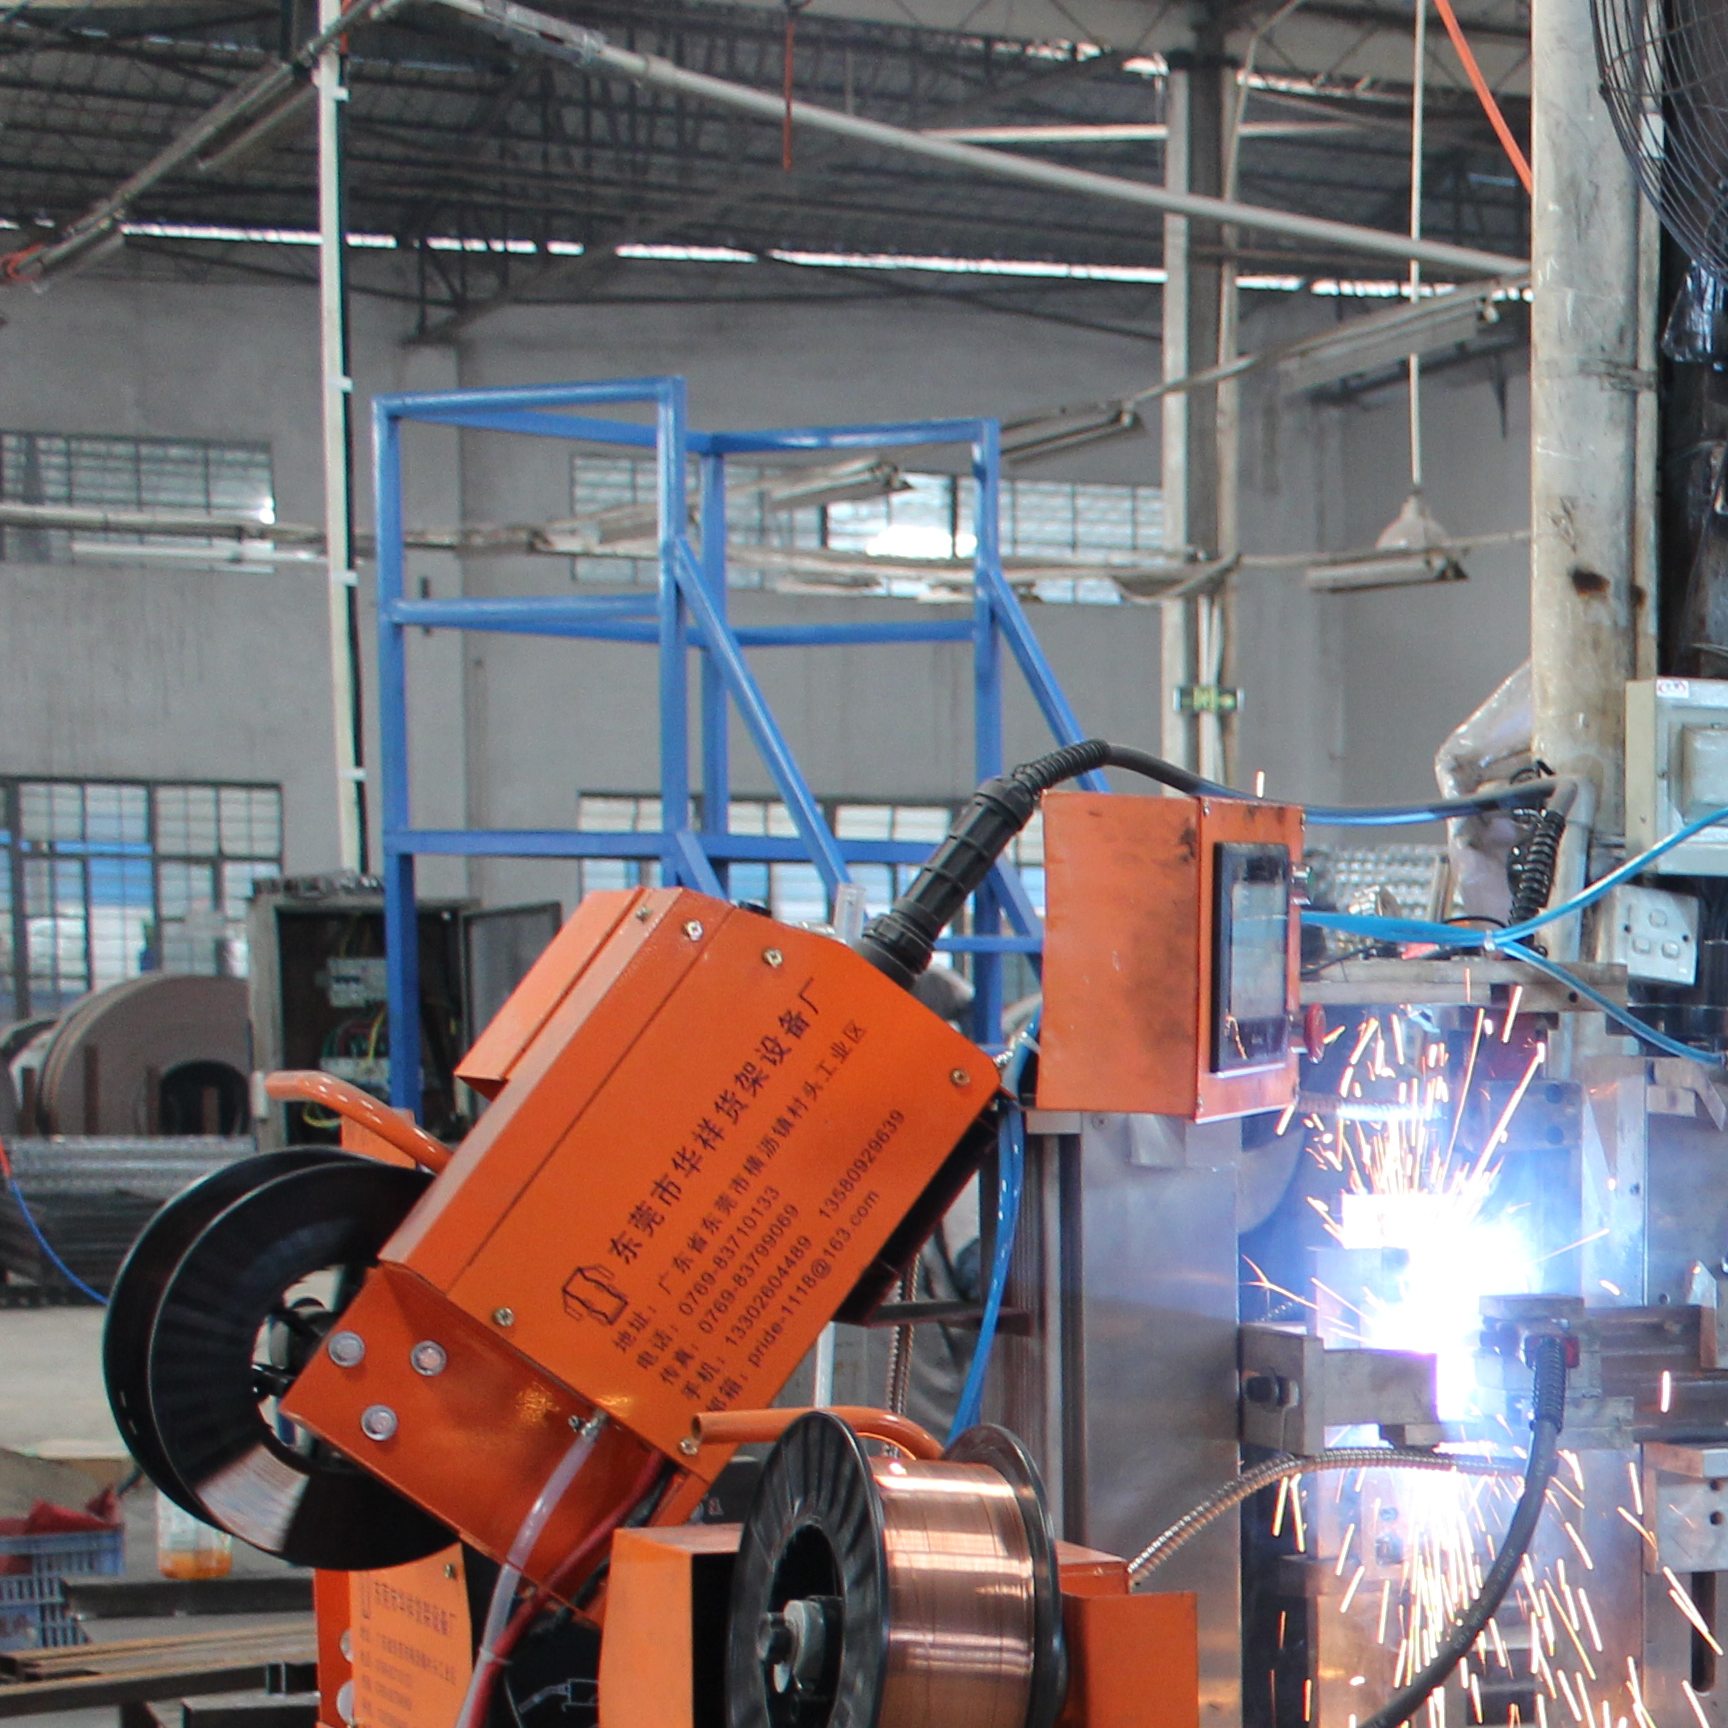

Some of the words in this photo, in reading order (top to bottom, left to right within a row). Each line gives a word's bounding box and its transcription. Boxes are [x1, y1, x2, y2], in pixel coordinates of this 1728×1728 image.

[608, 977, 820, 1266] 东莞市华祥货架设备厂
[655, 1020, 868, 1297] 广东省东莞市横沥镇村头工业区
[676, 1186, 780, 1318] 0769-83710133
[699, 1204, 800, 1334] 0769-83799069
[725, 1236, 812, 1346] 13302604489
[819, 1109, 904, 1217] 13580929639
[746, 1190, 880, 1370] pride-1118@163.com
